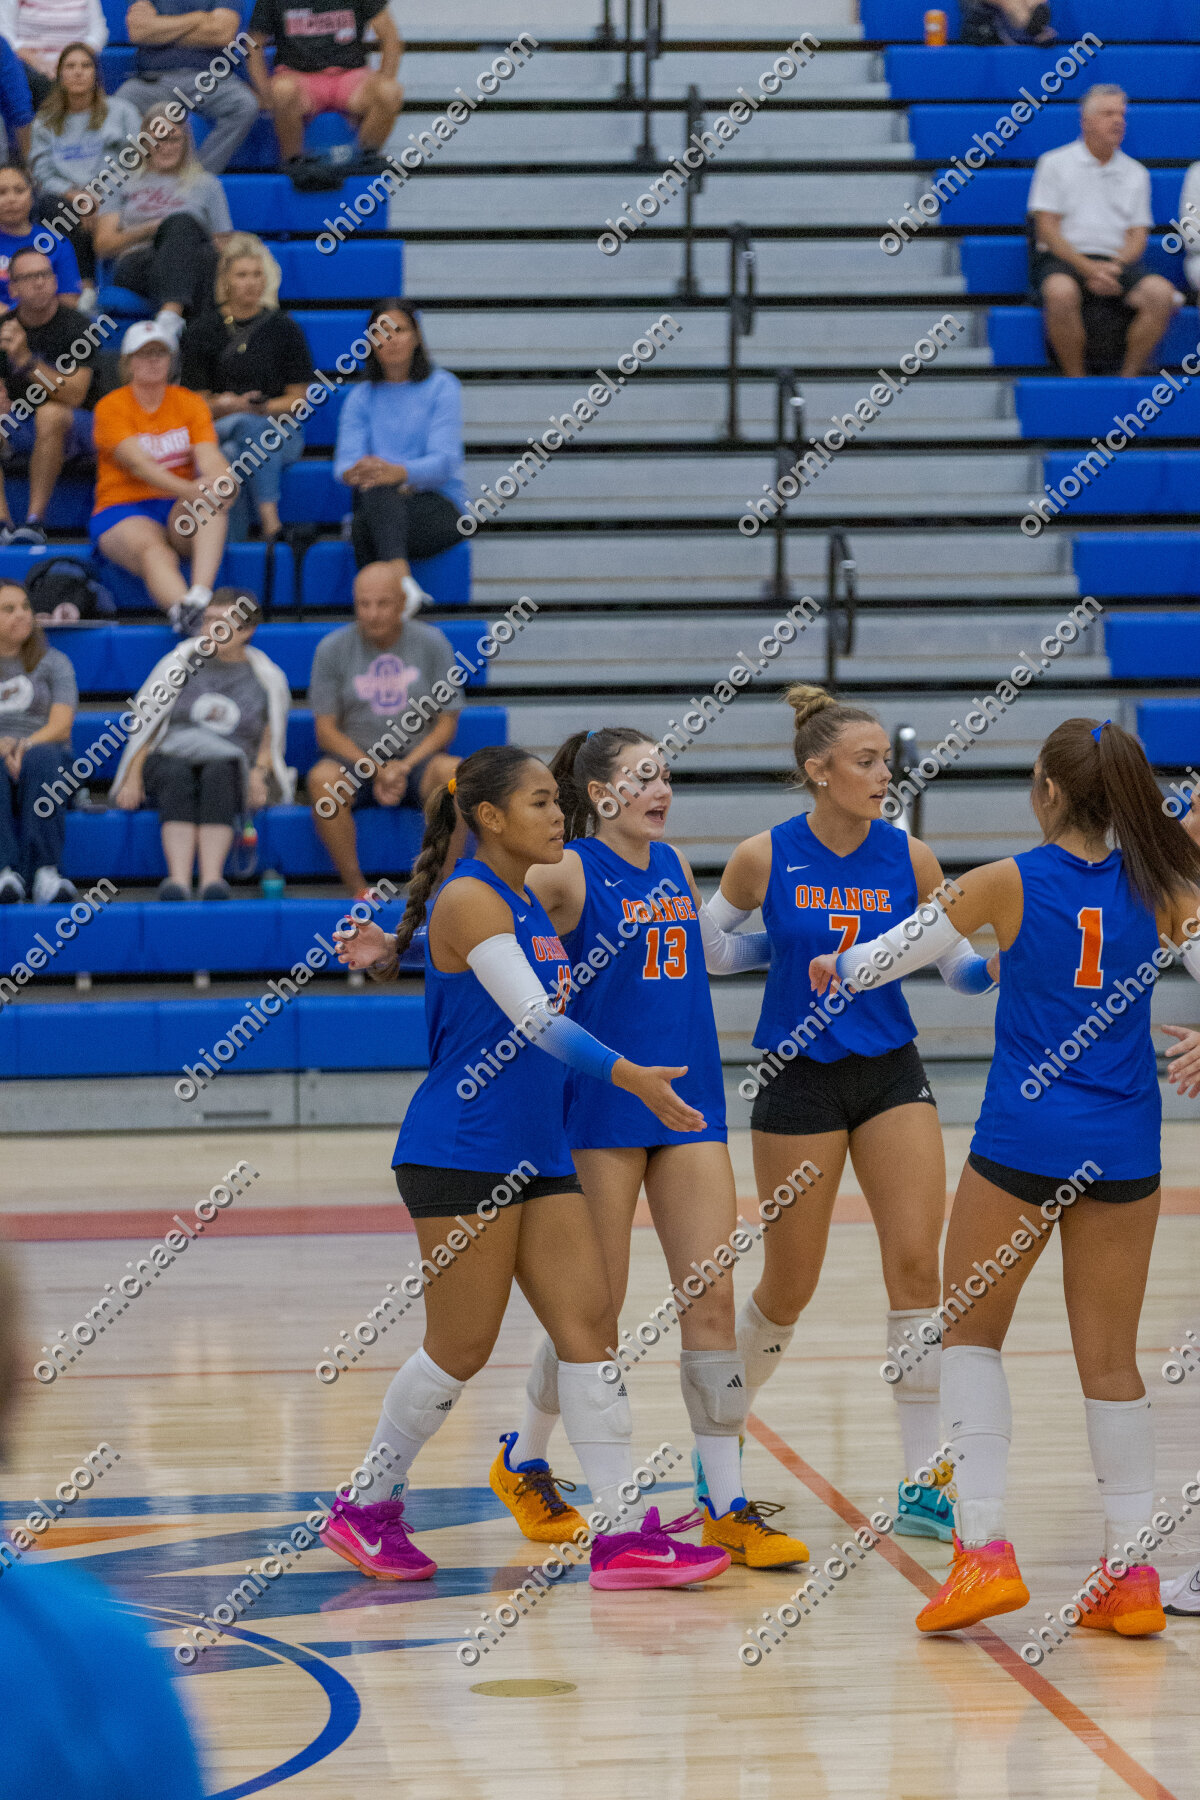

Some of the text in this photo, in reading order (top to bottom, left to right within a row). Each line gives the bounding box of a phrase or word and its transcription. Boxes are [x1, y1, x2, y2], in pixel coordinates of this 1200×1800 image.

[621, 896, 698, 923] ORANGE
[795, 884, 892, 913] ORANGE
[642, 925, 688, 980] 13
[829, 914, 860, 954] 7
[1073, 906, 1104, 989] 1
